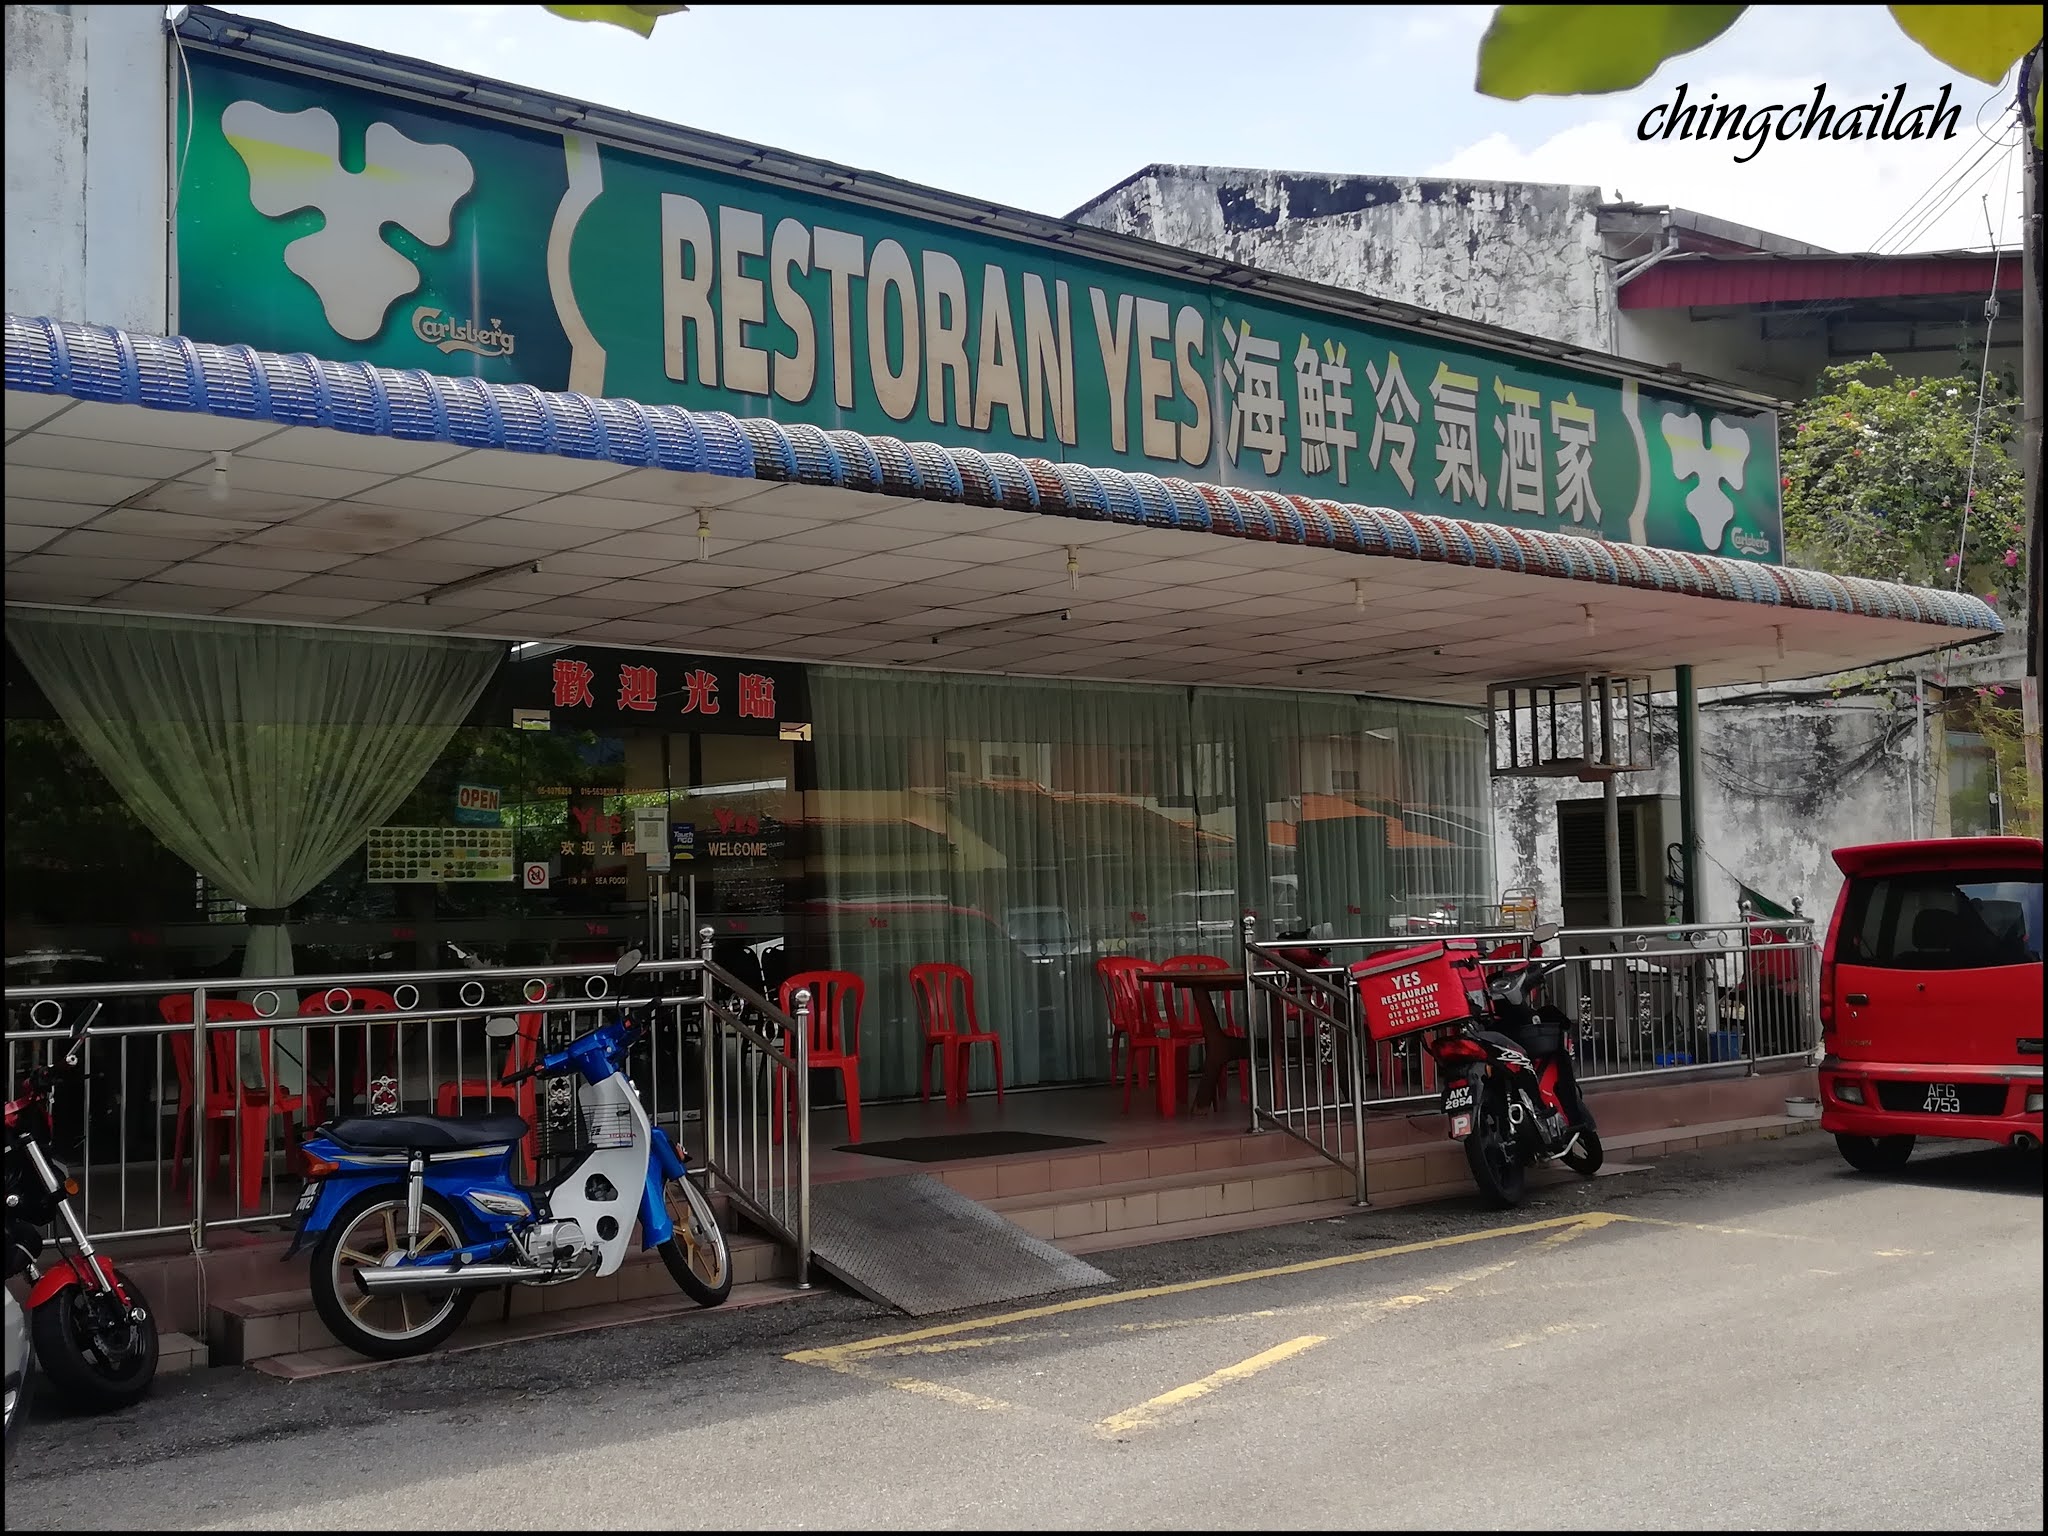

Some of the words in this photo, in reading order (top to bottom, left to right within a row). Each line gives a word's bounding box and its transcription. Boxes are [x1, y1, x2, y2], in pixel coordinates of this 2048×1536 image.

[411, 306, 516, 356] Carlsberg
[661, 192, 1077, 446] RESTORAN
[1089, 286, 1212, 467] YES
[1222, 316, 1602, 524] 海鮮冷氣酒家
[552, 658, 776, 719] 歡迎光臨
[459, 787, 499, 810] OPEN
[560, 840, 635, 857] 欢迎光临
[708, 841, 768, 857] WELCOME
[595, 876, 607, 885] SEA
[1391, 971, 1421, 991] YES
[1381, 983, 1439, 1005] RESTAURANT
[1390, 1018, 1404, 1027] 016
[1450, 1086, 1470, 1100] AKY
[1927, 1083, 1956, 1099] AFG
[1445, 1095, 1473, 1110] 2854
[1922, 1097, 1960, 1113] 4753
[1454, 1117, 1468, 1134] P
